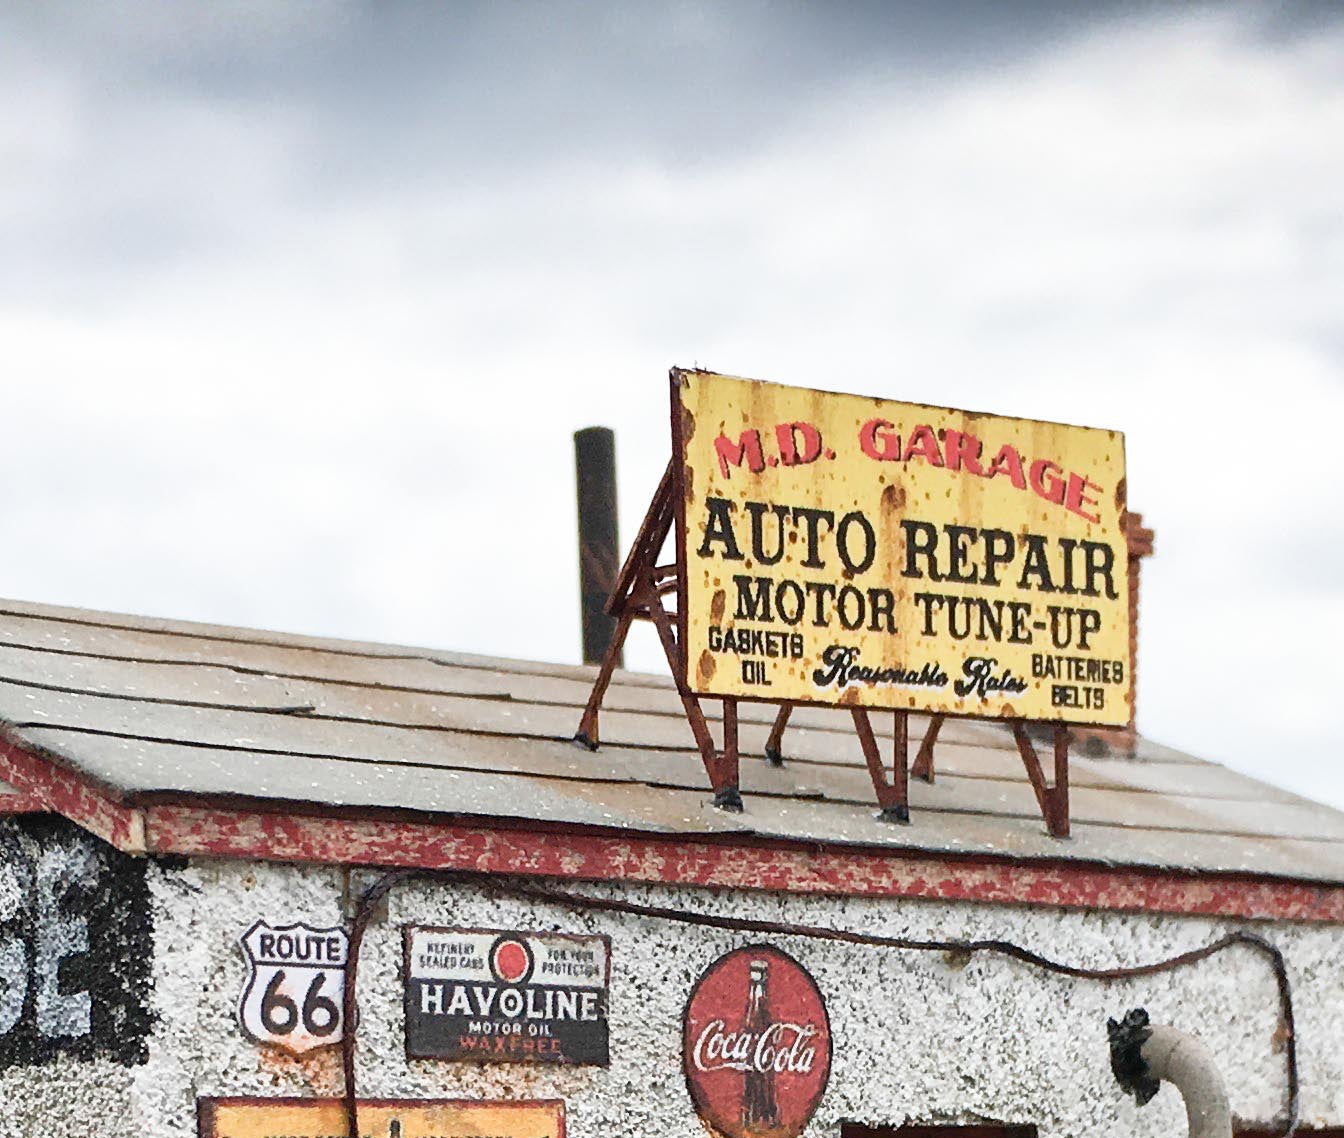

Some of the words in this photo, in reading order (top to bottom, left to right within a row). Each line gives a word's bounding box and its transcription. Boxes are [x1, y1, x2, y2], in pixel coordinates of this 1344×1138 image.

[714, 421, 836, 480] M.D.
[858, 417, 1104, 525] GARAGE
[696, 496, 877, 577] AUTO
[900, 519, 1120, 601] REPAIR
[732, 574, 899, 635] MOTOR
[913, 592, 1102, 651] TUNE-UP
[708, 626, 804, 659] GASKETS
[741, 660, 773, 686] OIL
[812, 644, 949, 688] Reasonable
[955, 656, 1028, 698] Rates
[1031, 652, 1124, 685] BATTERIES
[1051, 683, 1106, 711] BELTS
[259, 933, 341, 961] ROUTE
[260, 969, 340, 1037] 66
[421, 983, 599, 1021] HAVOLINE
[468, 1021, 522, 1036] MOTOR
[528, 1022, 553, 1037] OIL
